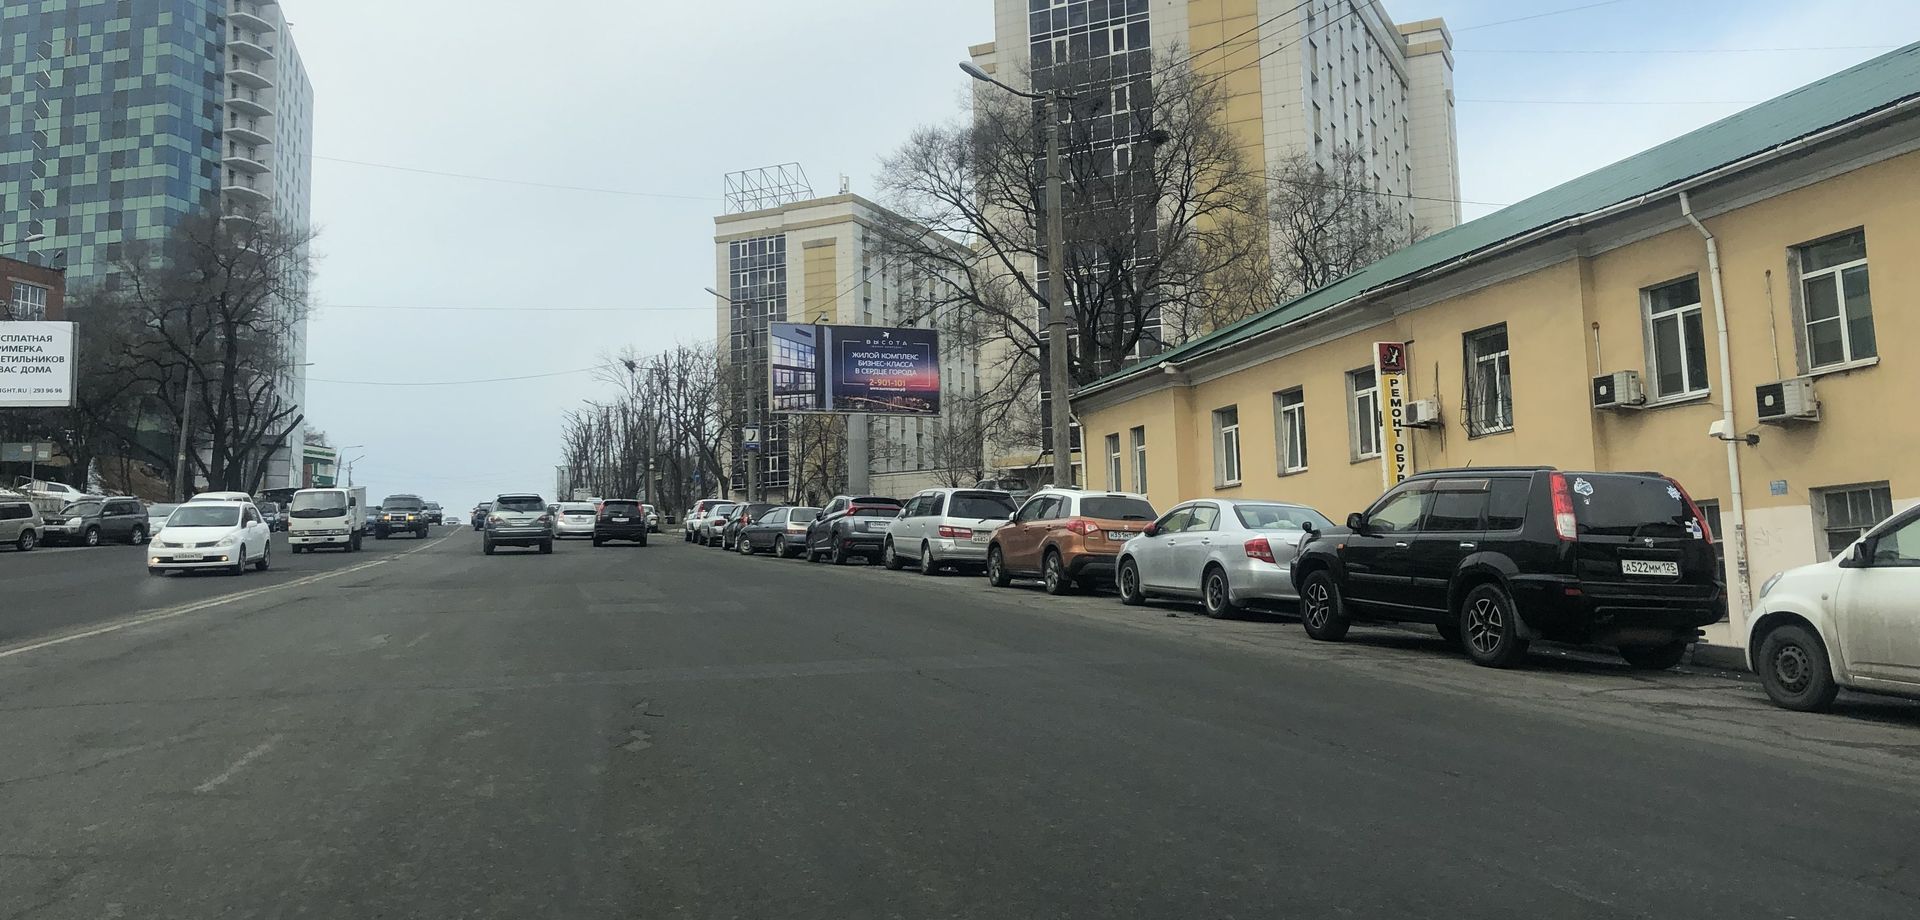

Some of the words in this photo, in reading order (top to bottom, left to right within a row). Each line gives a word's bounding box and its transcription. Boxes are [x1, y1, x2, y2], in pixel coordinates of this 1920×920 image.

[20, 365, 52, 374] ДОМА
[869, 379, 906, 387] 2-901-101
[1390, 379, 1402, 438] РЕМОНТ
